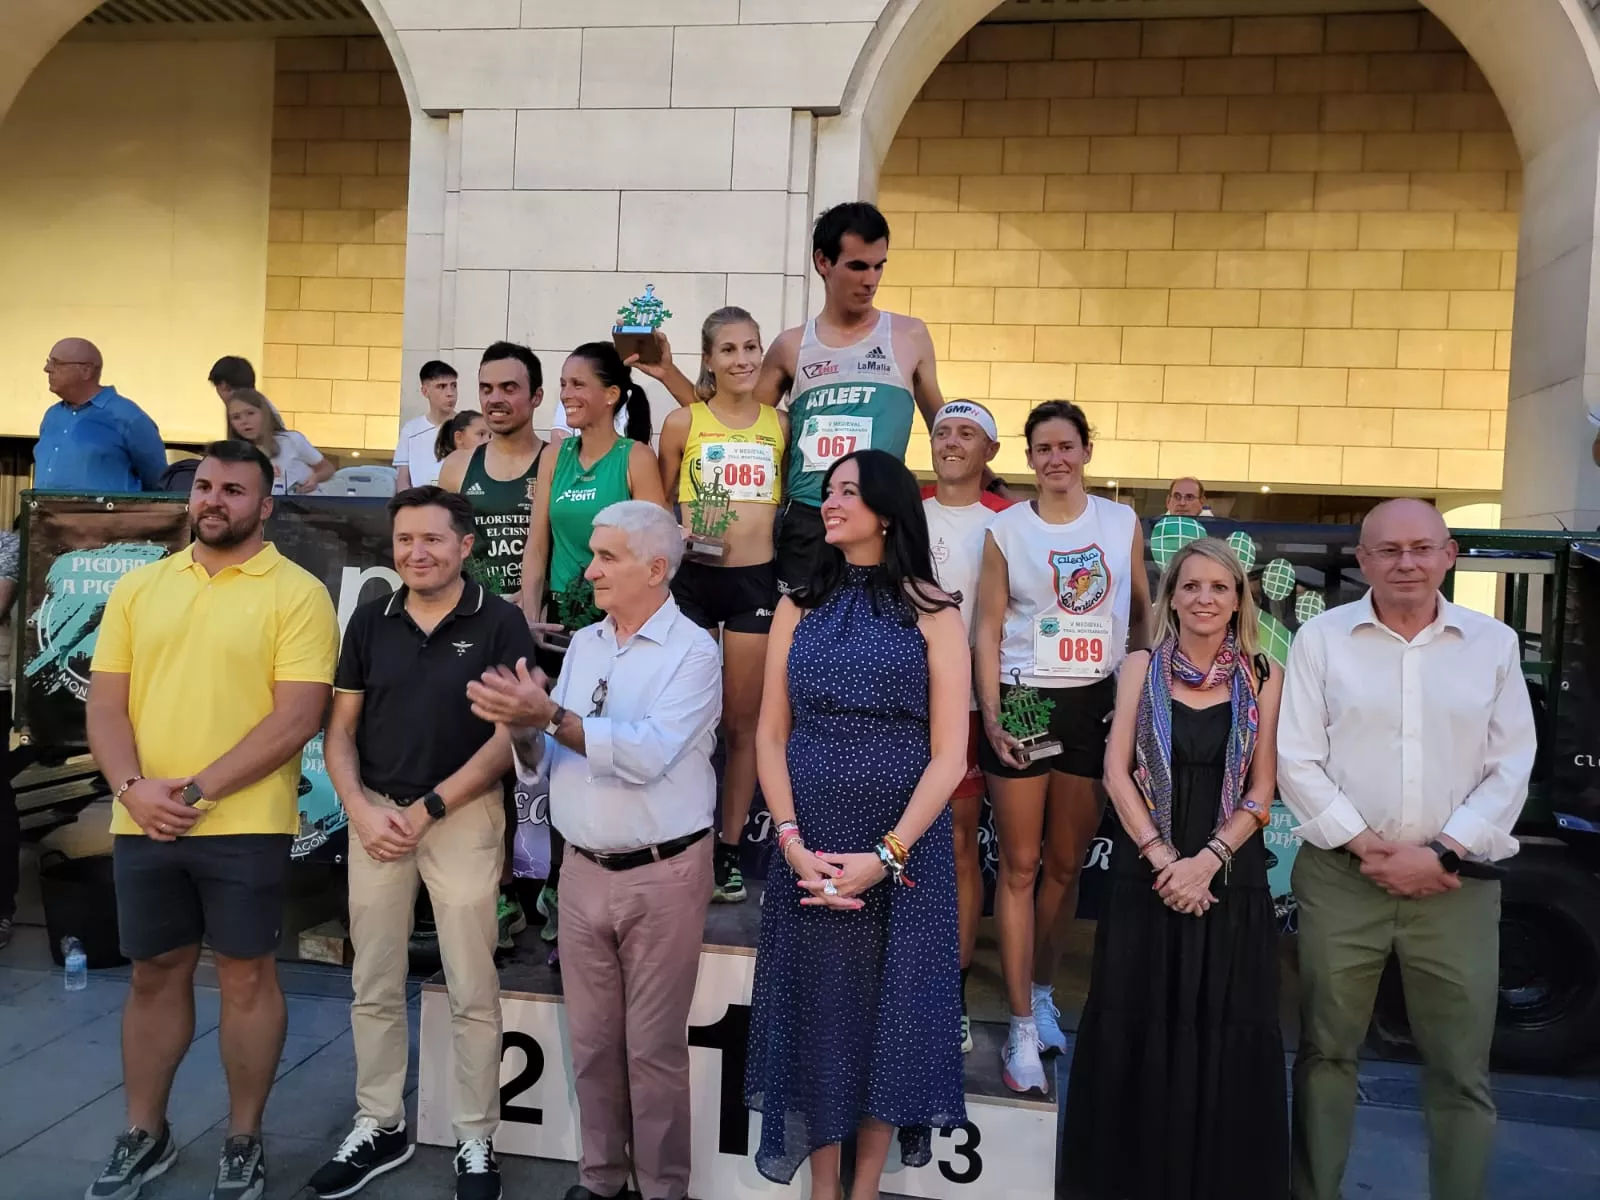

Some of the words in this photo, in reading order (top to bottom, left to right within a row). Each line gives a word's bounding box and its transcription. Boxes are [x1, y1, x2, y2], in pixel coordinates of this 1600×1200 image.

[806, 386, 877, 410] ATLEET
[817, 435, 857, 457] 067
[724, 463, 766, 487] 085
[486, 528, 501, 537] EL
[501, 527, 530, 536] CISN
[487, 539, 524, 557] JAC
[82, 579, 116, 595] PIE
[1058, 637, 1103, 663] 089
[59, 672, 89, 697] MON
[499, 1031, 545, 1125] 2
[688, 1004, 751, 1156] 1
[937, 1121, 984, 1184] 3
